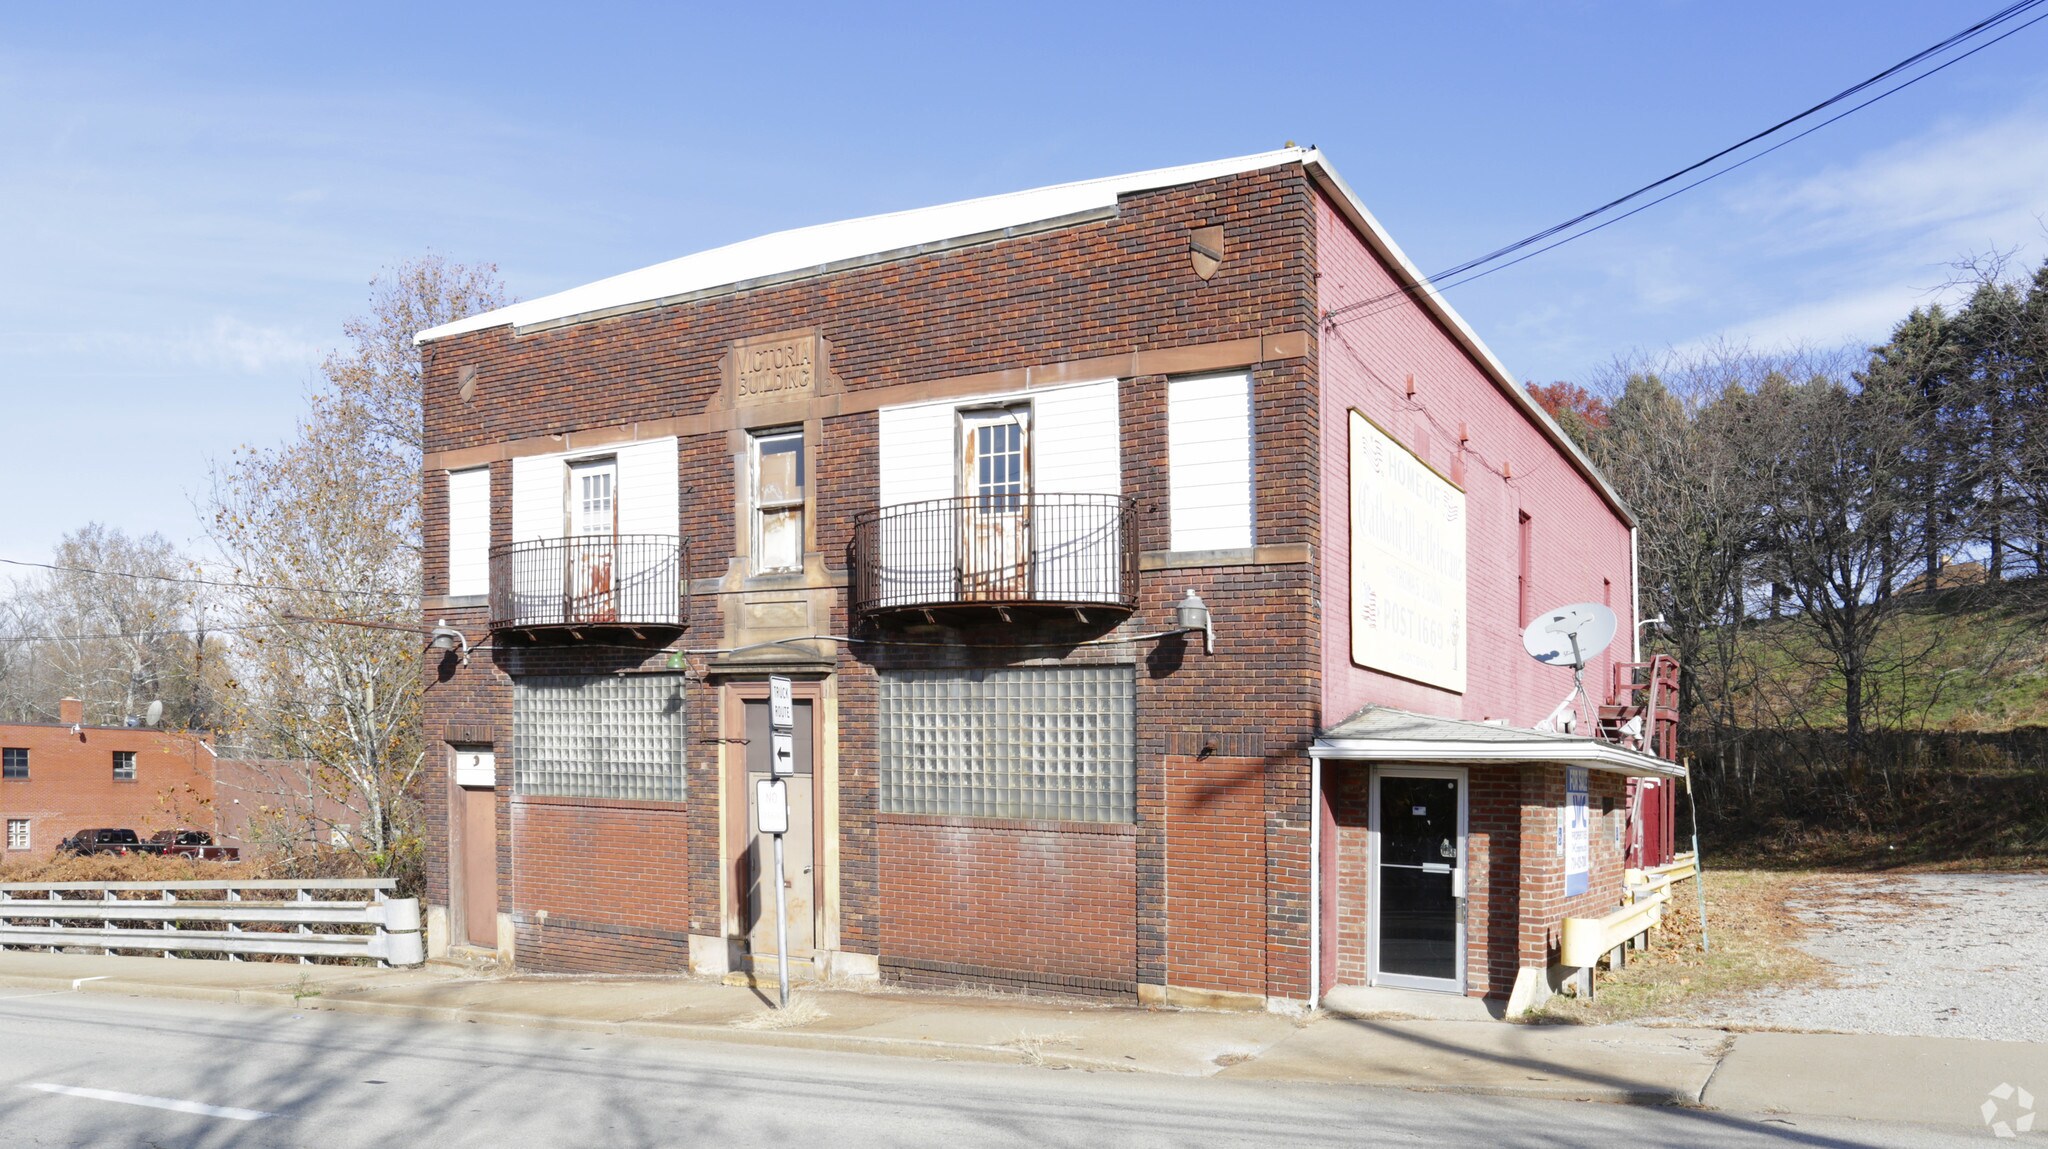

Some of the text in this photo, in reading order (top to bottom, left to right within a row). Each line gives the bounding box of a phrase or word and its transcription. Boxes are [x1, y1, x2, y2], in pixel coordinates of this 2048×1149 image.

[736, 342, 812, 374] VICTORIA
[738, 369, 810, 397] BUILDING
[1388, 450, 1440, 509] HOME OF
[1358, 479, 1402, 553] Catholic
[1384, 598, 1443, 650] POST 1669
[773, 685, 788, 699] TRUCK
[775, 705, 790, 718] ROUTE
